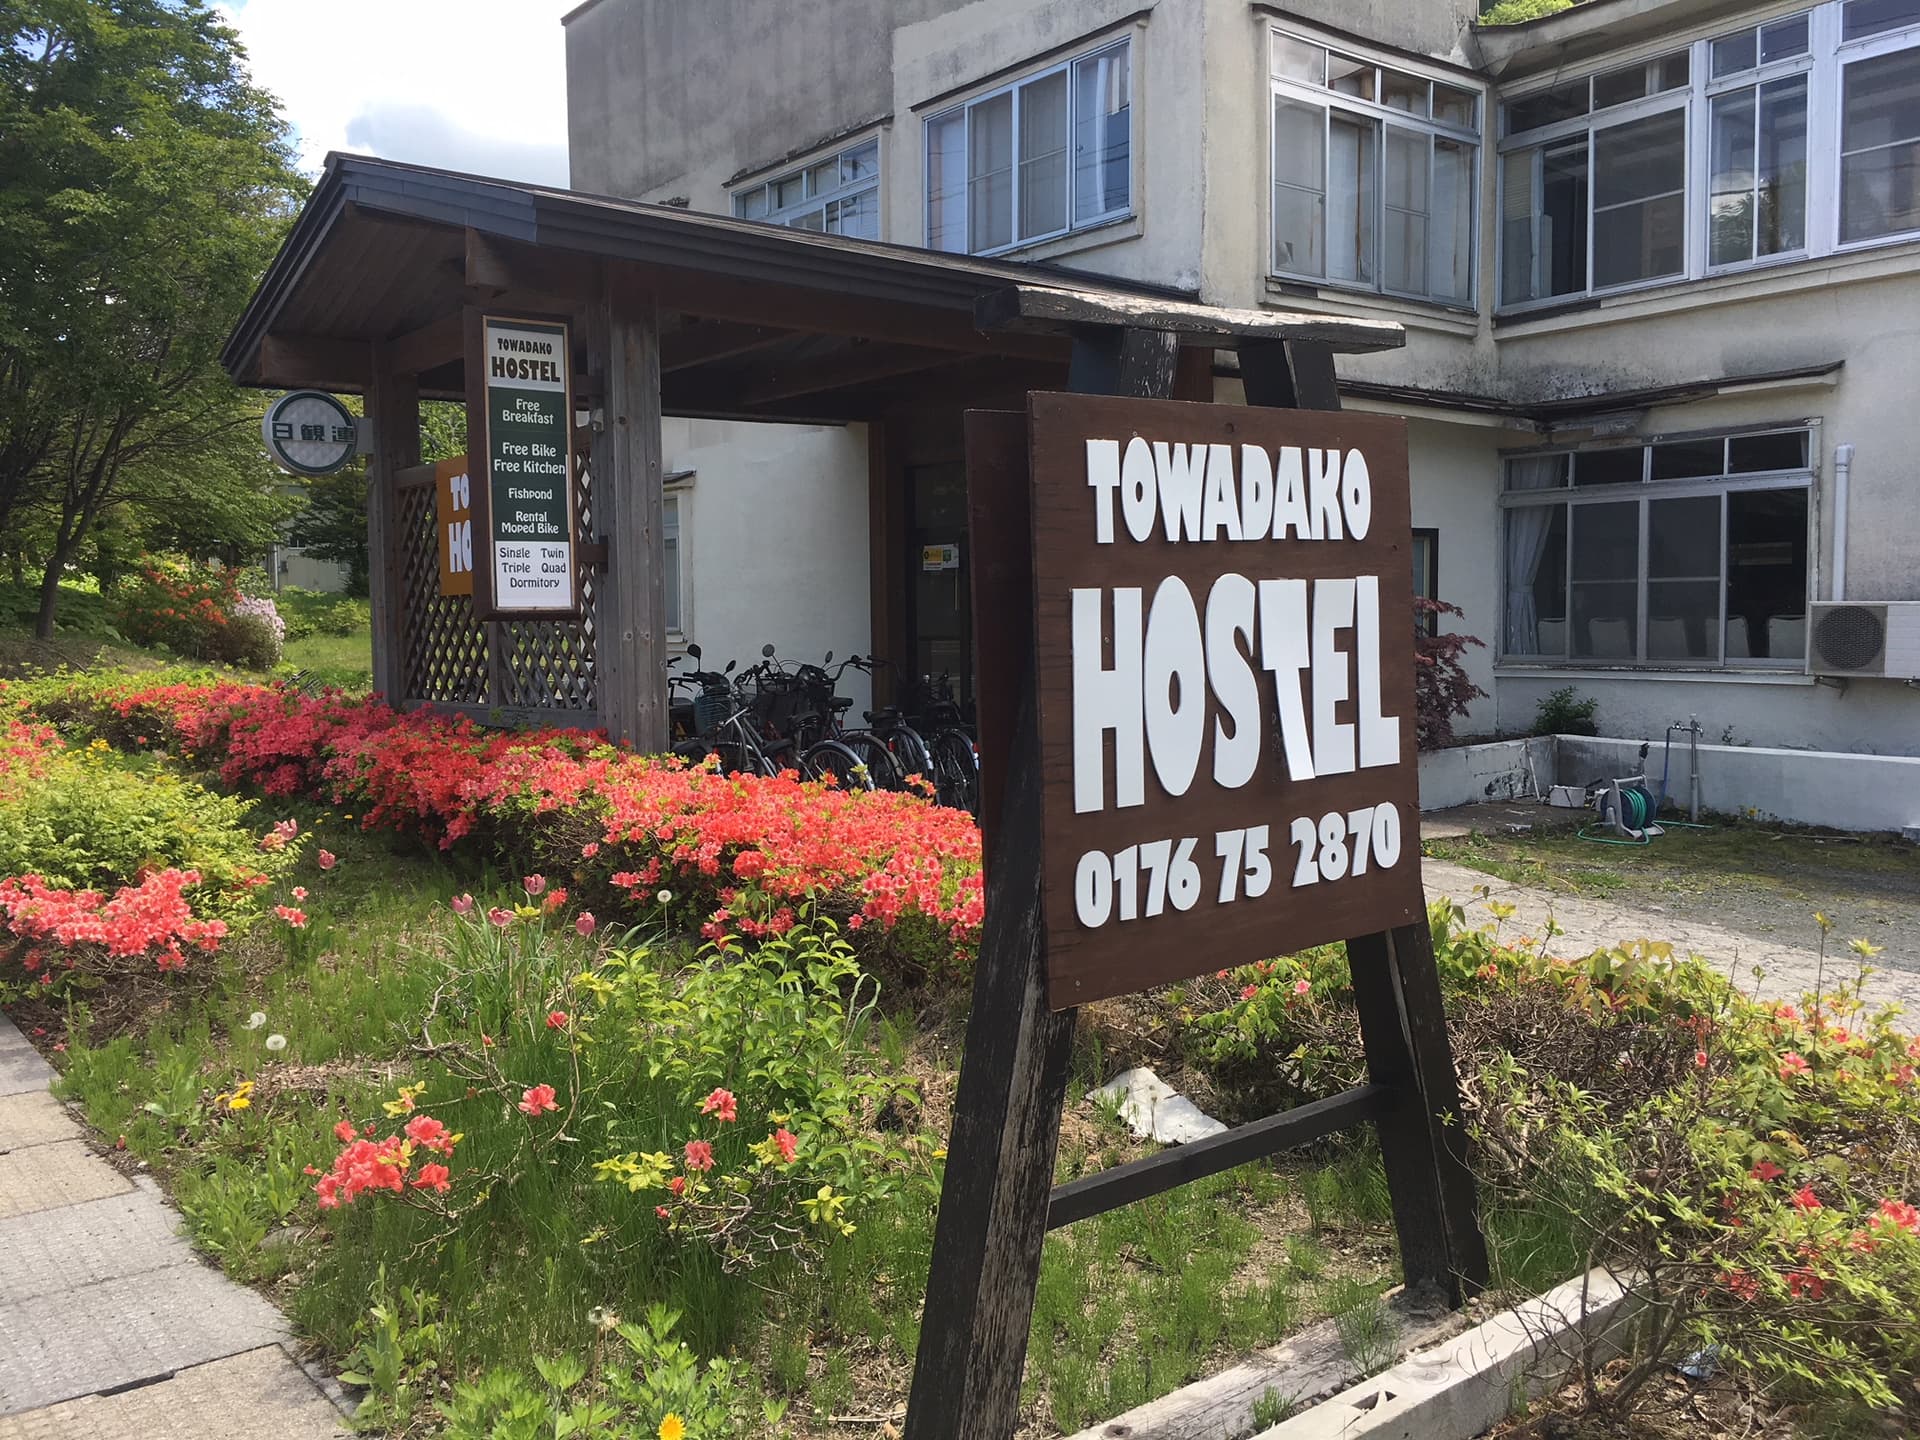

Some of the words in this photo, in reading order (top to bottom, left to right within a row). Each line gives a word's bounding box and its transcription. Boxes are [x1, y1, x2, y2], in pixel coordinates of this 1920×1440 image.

[497, 338, 552, 355] TOWADAKO
[491, 356, 561, 382] HOSTEL
[516, 398, 540, 411] Free
[502, 410, 554, 424] Breakfast
[502, 442, 529, 455] Free
[531, 443, 557, 457] Bike
[494, 459, 520, 472] Free
[523, 460, 566, 475] Kitchen
[508, 487, 553, 500] Fishpond
[1086, 436, 1371, 544] TOWADAKO
[515, 511, 548, 522] Rental
[501, 522, 535, 534] Moped
[537, 523, 559, 534] Bike
[499, 547, 531, 559] Single
[540, 548, 564, 559] Twin
[501, 562, 531, 573] Triple
[541, 563, 566, 574] Quad
[510, 577, 560, 589] Dormitory
[1071, 572, 1400, 814] HOSTEL
[1075, 837, 1201, 928] 0176
[1215, 824, 1273, 903] 75
[1291, 801, 1401, 888] 2870
